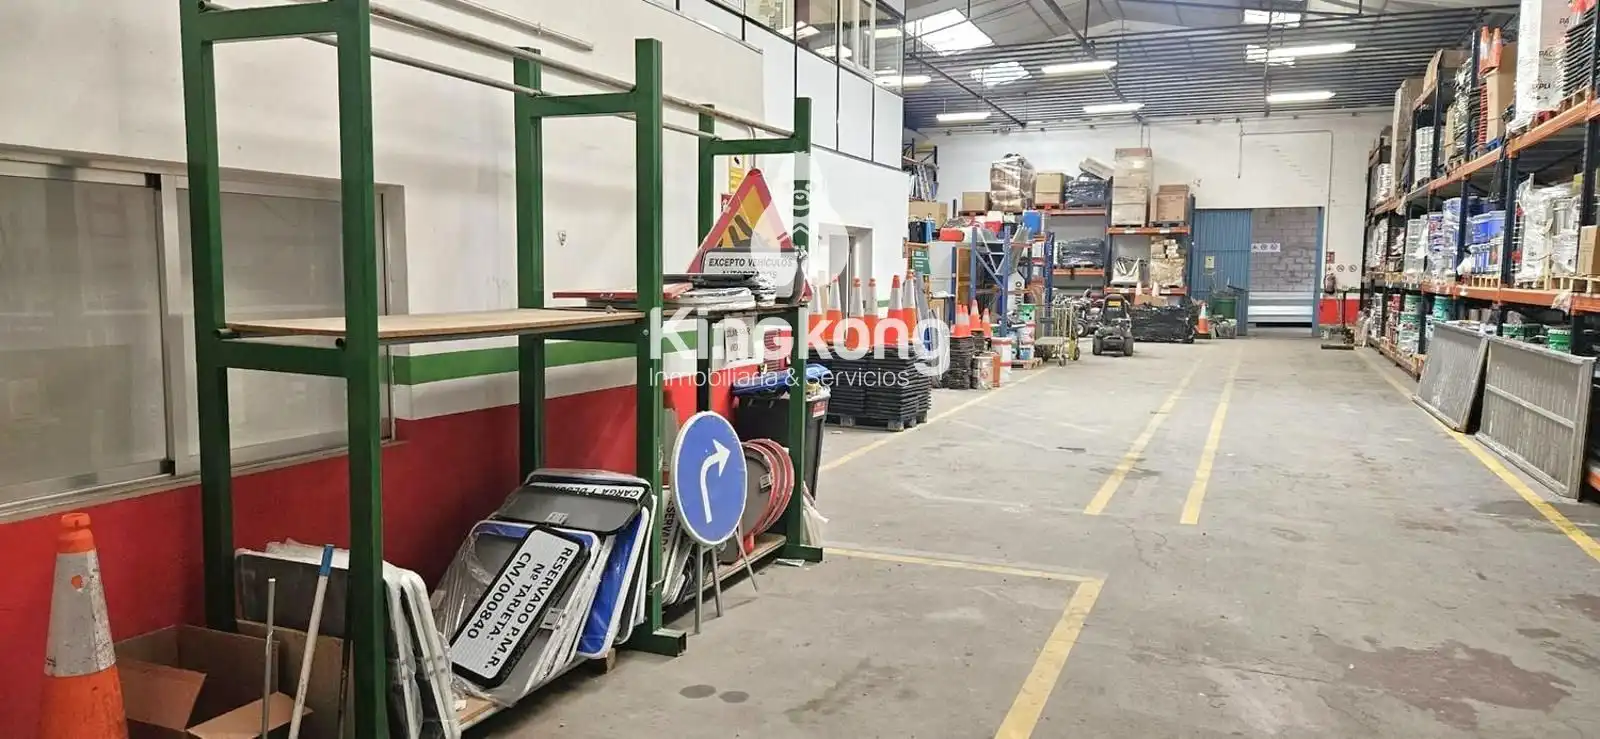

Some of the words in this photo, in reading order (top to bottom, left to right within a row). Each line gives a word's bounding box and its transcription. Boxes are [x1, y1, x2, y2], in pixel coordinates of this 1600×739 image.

[708, 258, 746, 267] EXCEPTO
[467, 552, 531, 639] CM/000840
[486, 583, 533, 641] TARJETA:
[517, 547, 574, 624] RESERVADO
[484, 627, 521, 669] P.M.R.
